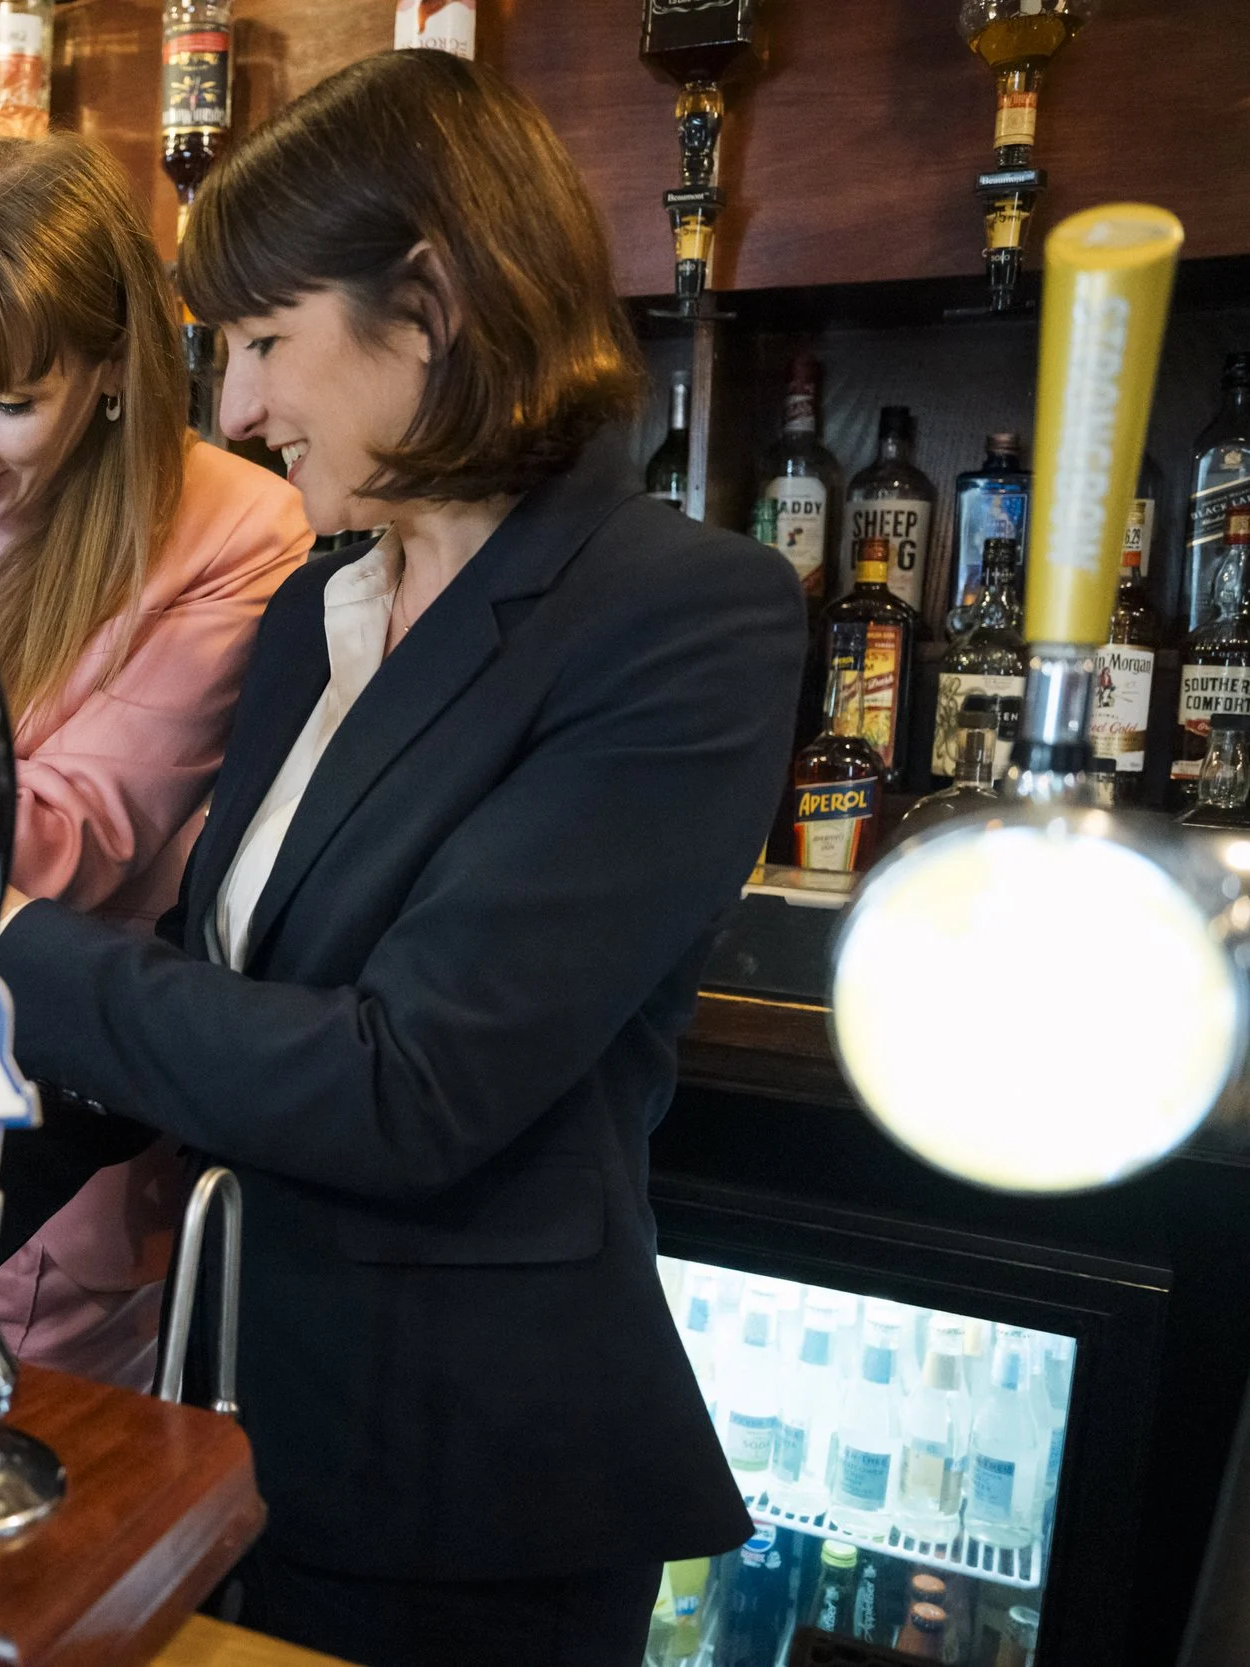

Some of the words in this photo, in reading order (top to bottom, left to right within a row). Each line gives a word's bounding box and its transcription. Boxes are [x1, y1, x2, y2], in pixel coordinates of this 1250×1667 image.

[778, 501, 824, 515] ADDY
[854, 510, 918, 539] SHEEP
[1109, 653, 1151, 674] Morgan
[798, 790, 867, 818] APEROL
